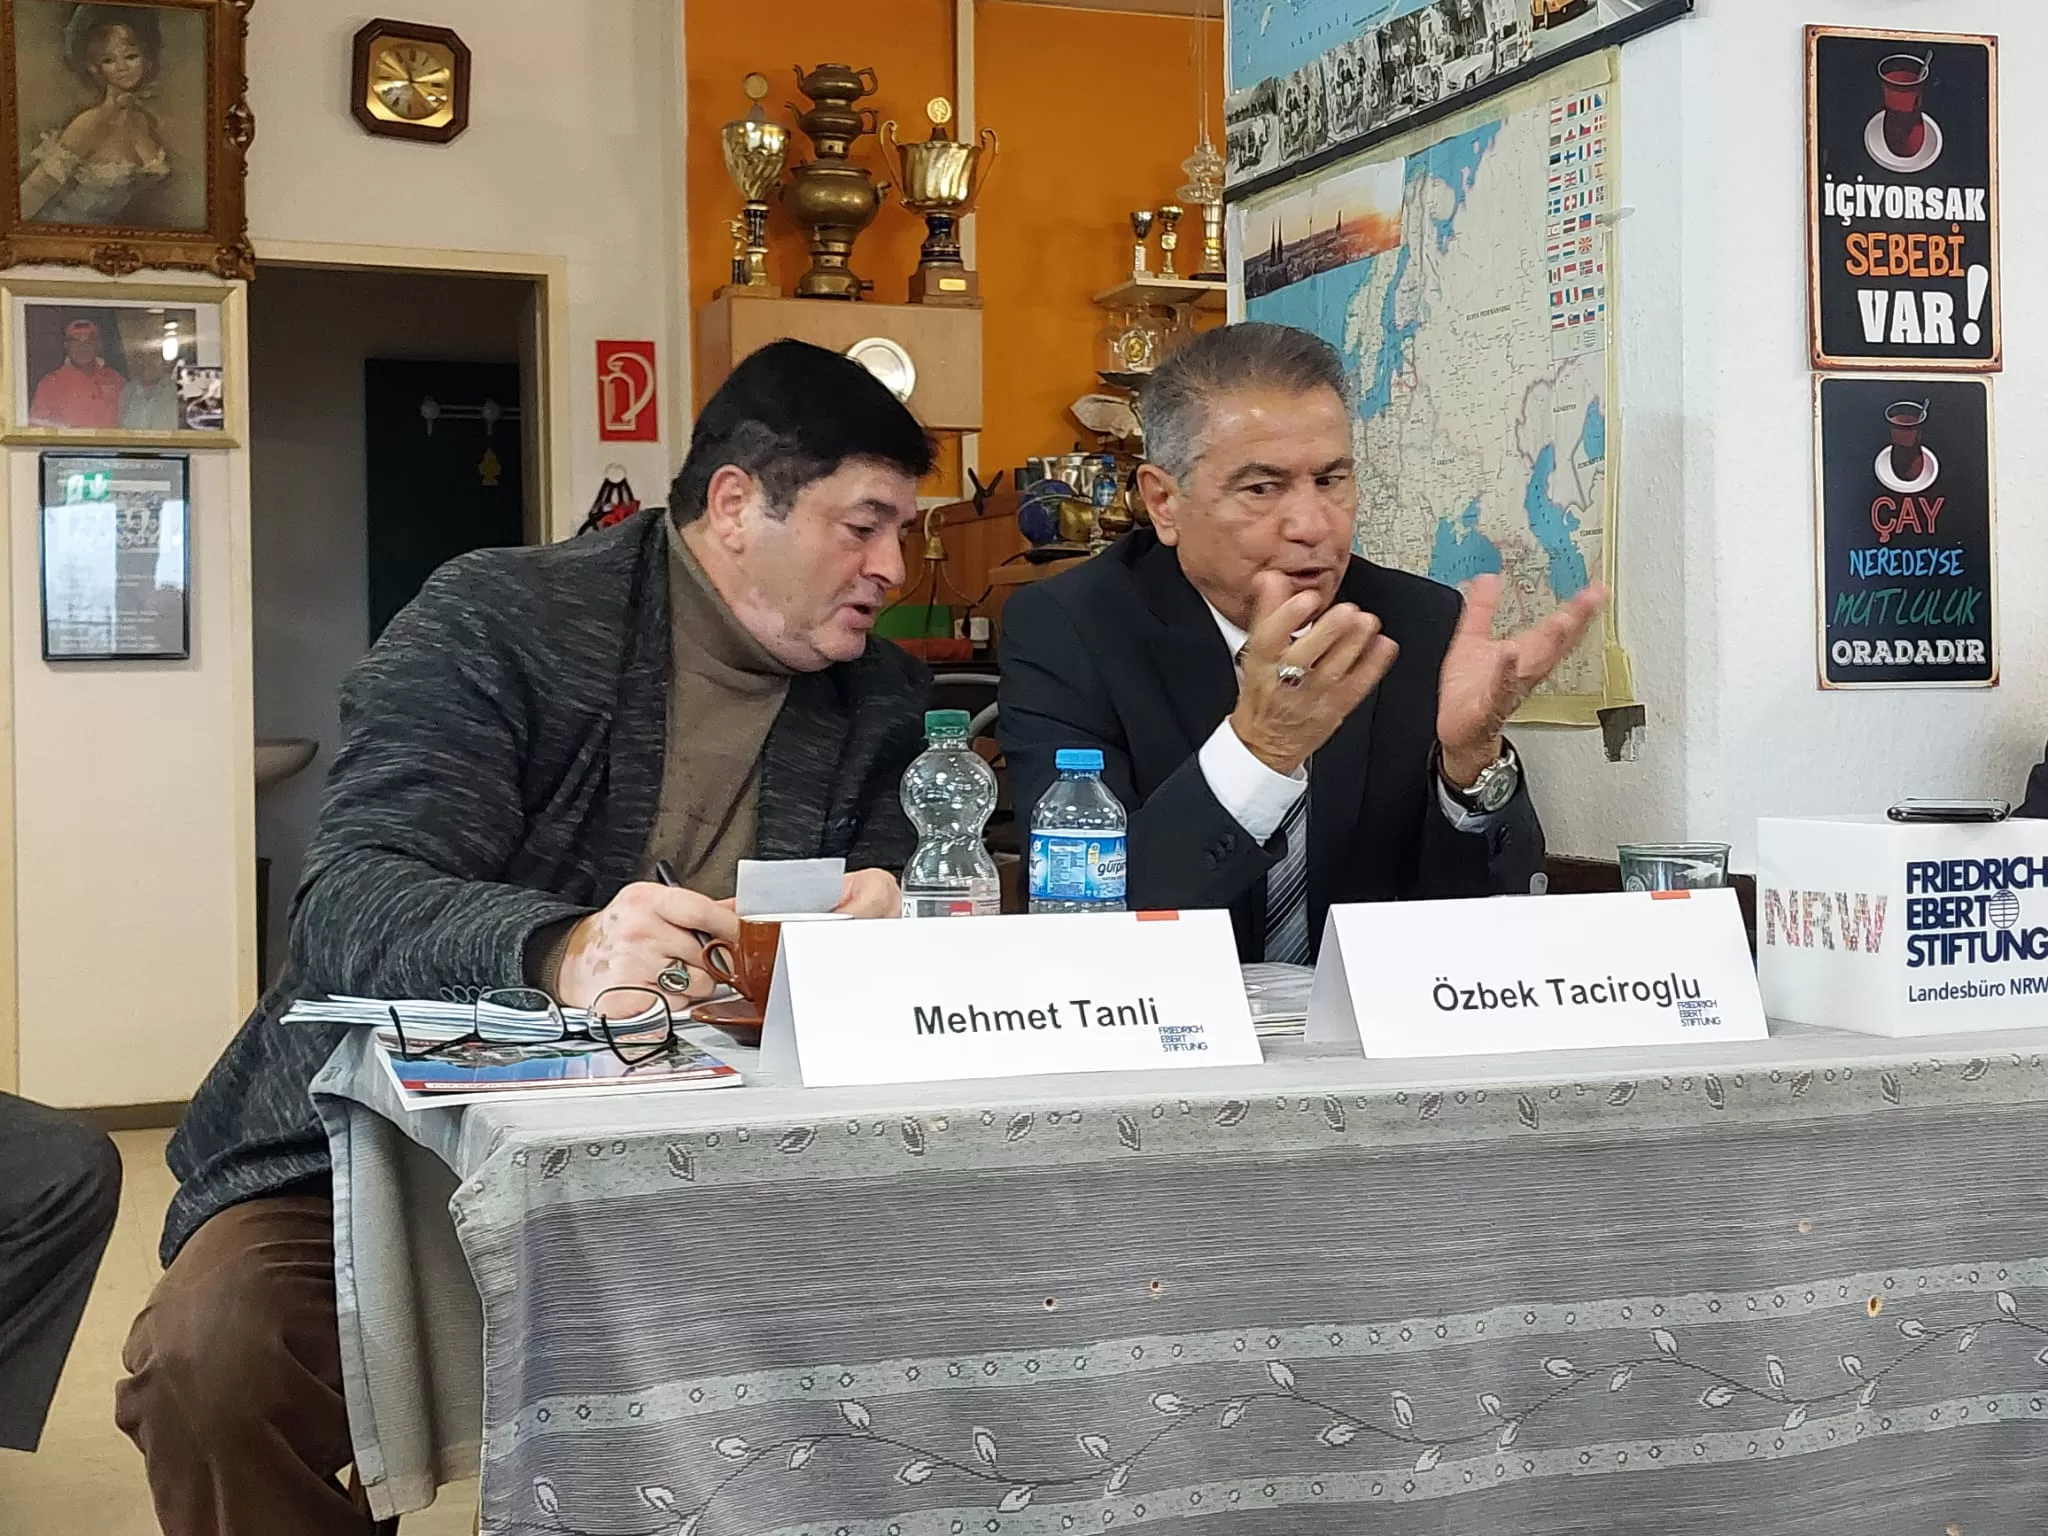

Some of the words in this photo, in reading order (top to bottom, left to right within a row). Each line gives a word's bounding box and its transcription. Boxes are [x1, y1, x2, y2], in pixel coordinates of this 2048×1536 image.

[1824, 173, 1986, 226] İÇİYORSAK
[1845, 223, 1966, 278] SEBEBİ
[1870, 496, 1945, 543] ÇAY
[1848, 547, 1965, 579] NEREDEYSE
[1833, 586, 1982, 627] MUTLULUK
[1831, 638, 1987, 666] ORADADIR
[1906, 856, 2048, 894] FRIEDRICH
[1764, 888, 1888, 954] NRW
[1906, 895, 1990, 930] EBERT
[1906, 926, 2048, 968] STIFTUNG
[1432, 976, 1539, 1012] Özbek
[1545, 972, 1701, 1009] Taciroglu
[1908, 980, 2006, 1003] Landesbüro
[2010, 977, 2048, 995] NRW
[913, 1003, 1062, 1036] Mehmet
[1069, 996, 1160, 1029] Tanli
[1680, 1017, 1722, 1027] STIFTUNG
[1162, 1042, 1209, 1052] STIFTUNG
